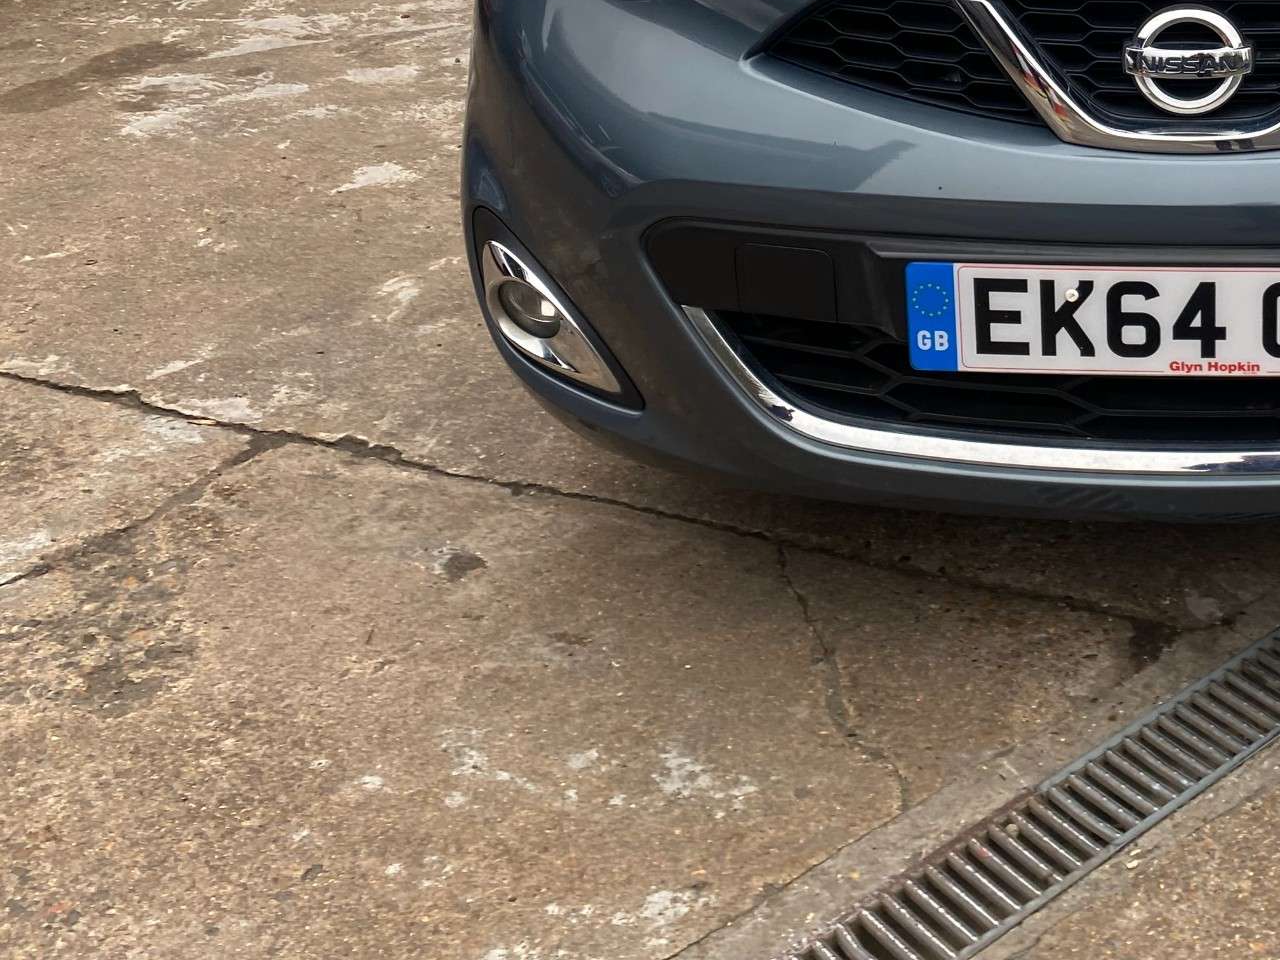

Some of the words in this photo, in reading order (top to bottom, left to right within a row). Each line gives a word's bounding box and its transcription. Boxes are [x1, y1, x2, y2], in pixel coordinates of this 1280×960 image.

[1138, 54, 1244, 74] NISSAN
[973, 277, 1226, 358] EK64
[917, 330, 949, 351] GB
[1169, 361, 1202, 373] Glyn
[1207, 361, 1260, 373] Hopkin
